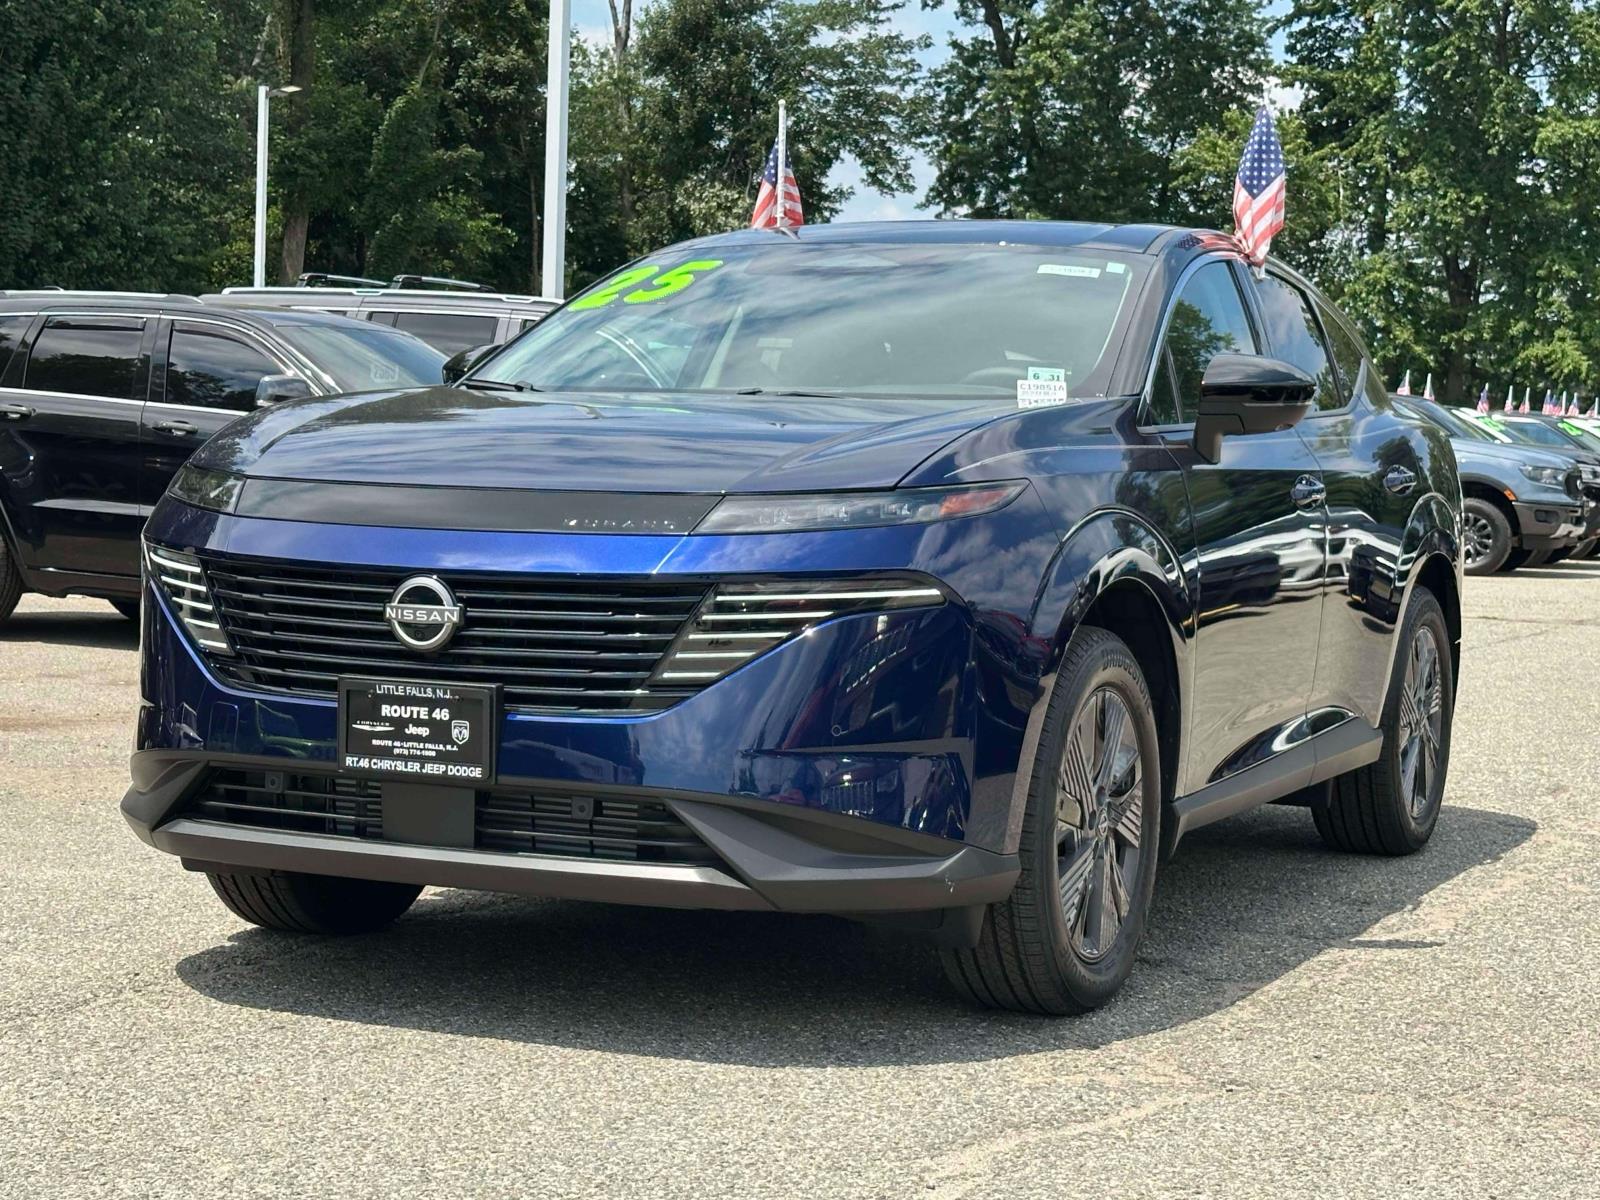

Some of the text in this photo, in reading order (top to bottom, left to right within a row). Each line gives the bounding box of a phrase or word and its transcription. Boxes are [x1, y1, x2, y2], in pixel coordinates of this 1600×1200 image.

[567, 260, 723, 312] 25
[386, 607, 457, 621] NISSAN
[376, 684, 453, 699] LITTLE FALLS, N.J.
[381, 704, 450, 721] ROUTE 46
[404, 723, 430, 737] Jeep
[345, 756, 482, 778] RT.46 CHRYSLER JEEP DODGE
